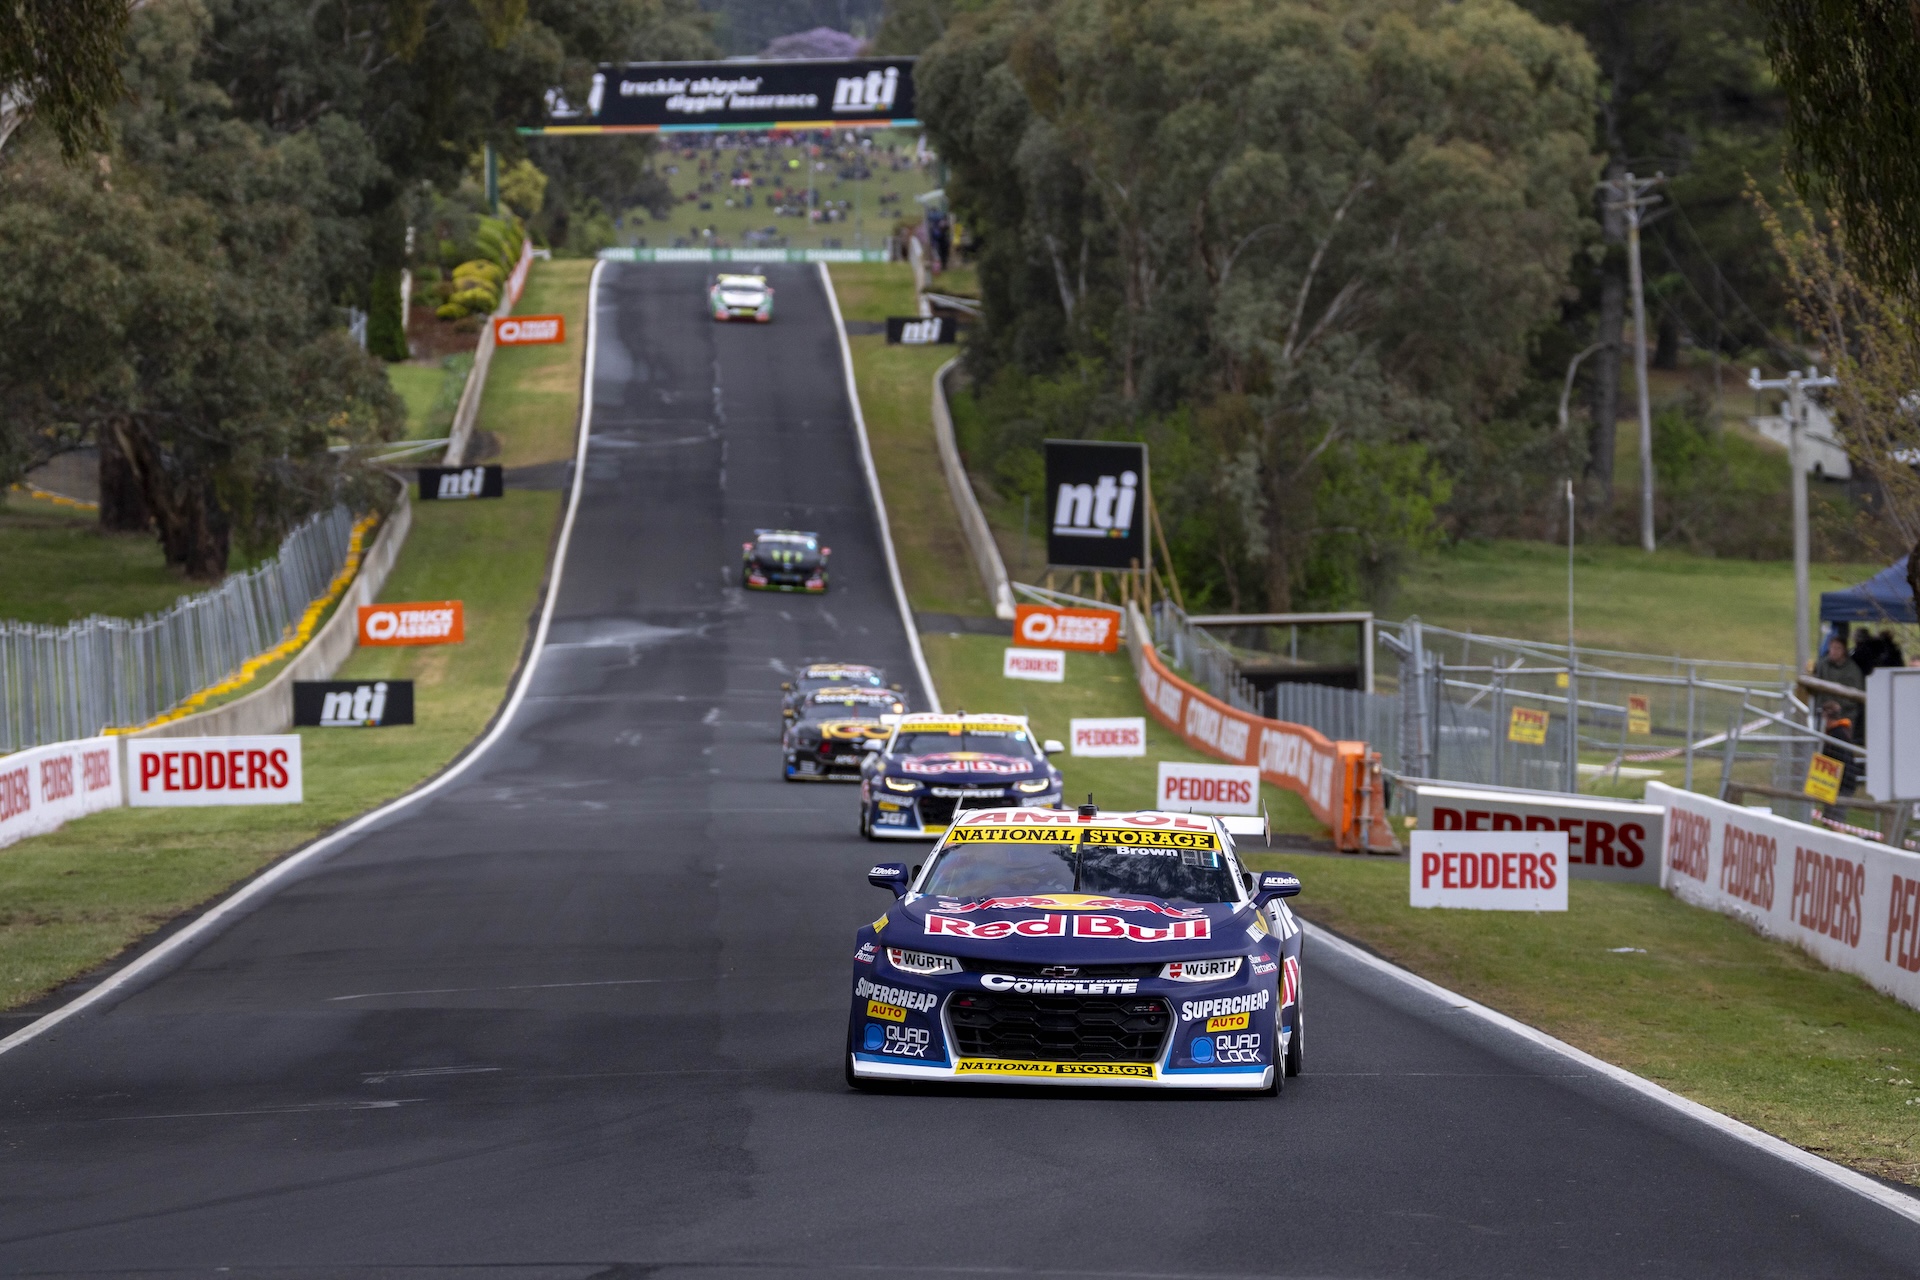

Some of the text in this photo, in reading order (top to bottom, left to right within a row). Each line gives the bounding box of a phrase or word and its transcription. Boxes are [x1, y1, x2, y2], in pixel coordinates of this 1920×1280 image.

[834, 66, 899, 106] nti
[438, 466, 486, 494] nti
[1055, 470, 1138, 529] nti
[399, 609, 455, 623] TRUCK
[395, 622, 453, 638] ASSIST
[322, 682, 389, 721] nti
[1076, 727, 1140, 748] PEDDERS
[140, 748, 289, 792] PEDDERS
[1165, 777, 1251, 804] PEDDERS
[953, 829, 1209, 847] NATIONAL STORAGE
[1116, 846, 1178, 856] Brown
[1421, 852, 1557, 889] PEDDERS
[1720, 823, 1777, 913] PEDDERS
[1790, 846, 1865, 949] PEDDERS
[924, 913, 1211, 942] Red Bull
[904, 952, 953, 970] WÜRTH
[1185, 960, 1236, 975] WÜRTH
[980, 973, 1138, 995] COMPLETE
[855, 977, 938, 1013] SUPERCHEAP
[1181, 989, 1269, 1021] SUPERCHEAP
[871, 1005, 902, 1018] AUTO
[1211, 1017, 1244, 1028] AUTO
[886, 1025, 930, 1044] QUAD
[1216, 1033, 1260, 1050] QUAD
[882, 1040, 929, 1057] LOCK
[1216, 1048, 1261, 1062] LOCK
[959, 1061, 1149, 1076] NATIONAL STORAGE
